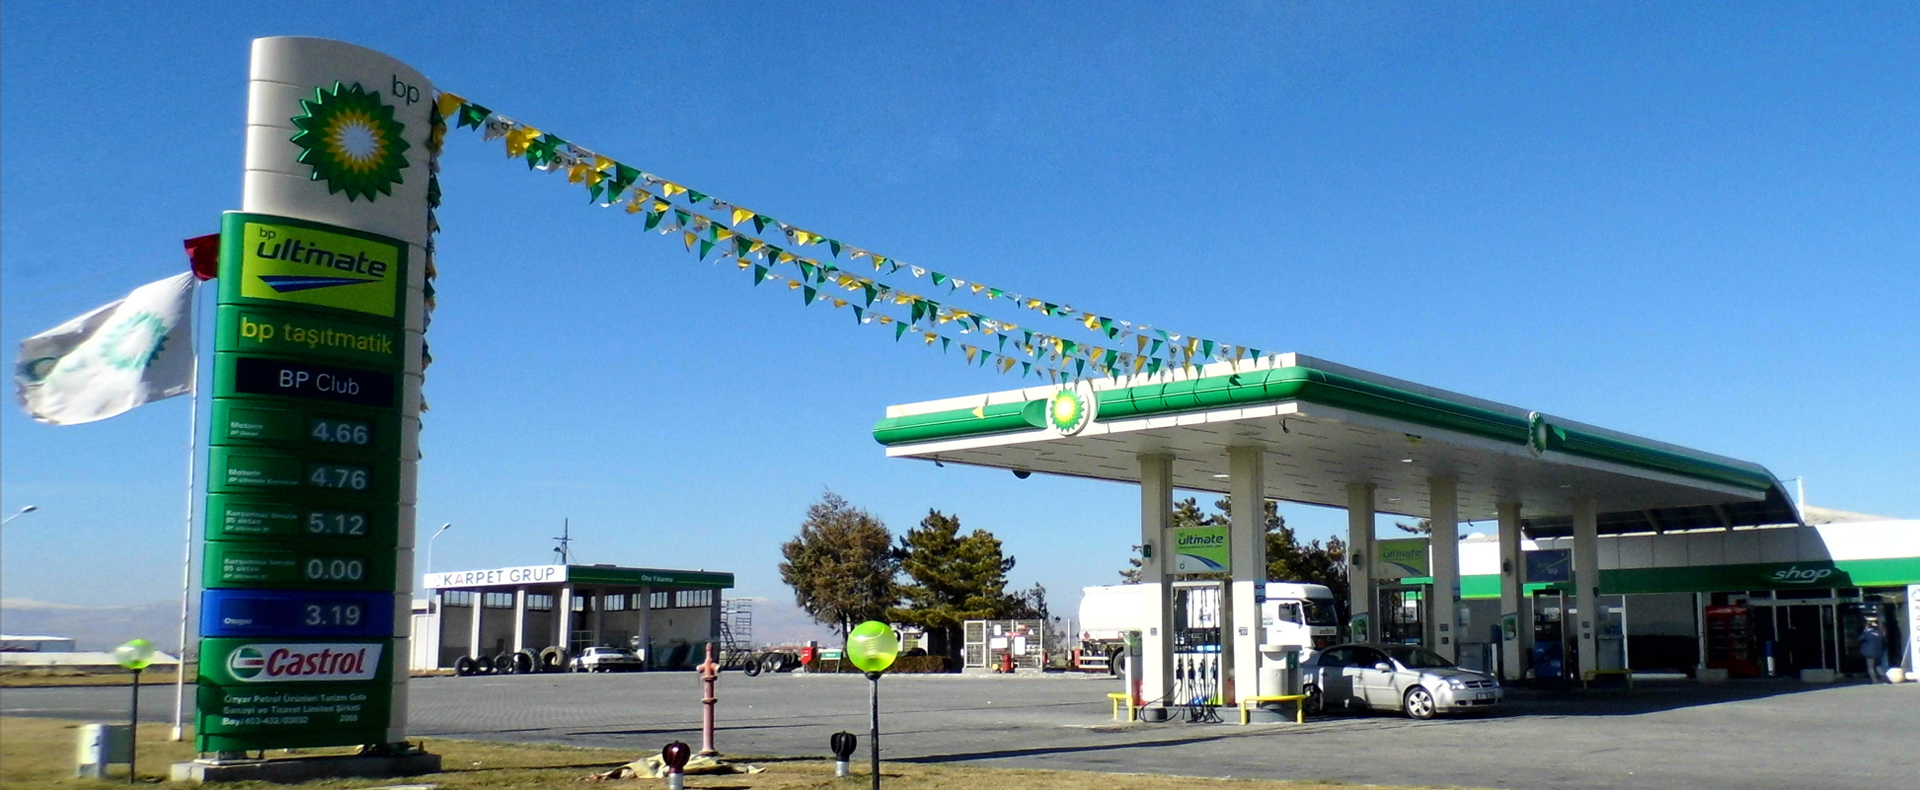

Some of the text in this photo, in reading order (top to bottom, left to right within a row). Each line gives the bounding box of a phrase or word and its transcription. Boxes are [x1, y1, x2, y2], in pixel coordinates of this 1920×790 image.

[392, 73, 420, 106] bp
[259, 227, 277, 239] bp
[256, 238, 388, 278] ultimate
[241, 316, 393, 354] bp taşıtmatik
[279, 369, 360, 396] BP Club
[313, 422, 368, 445] 4.66
[311, 467, 367, 490] 4.76
[310, 513, 364, 535] 5.12
[1178, 533, 1224, 546] ultimate
[308, 559, 362, 580] 0.00
[443, 567, 555, 586] KARPET GRUP
[1772, 565, 1832, 584] shop
[306, 605, 361, 626] 3.19
[266, 648, 367, 676] Castrol
[253, 694, 281, 703] Petrol
[271, 705, 301, 713] Ticaret
